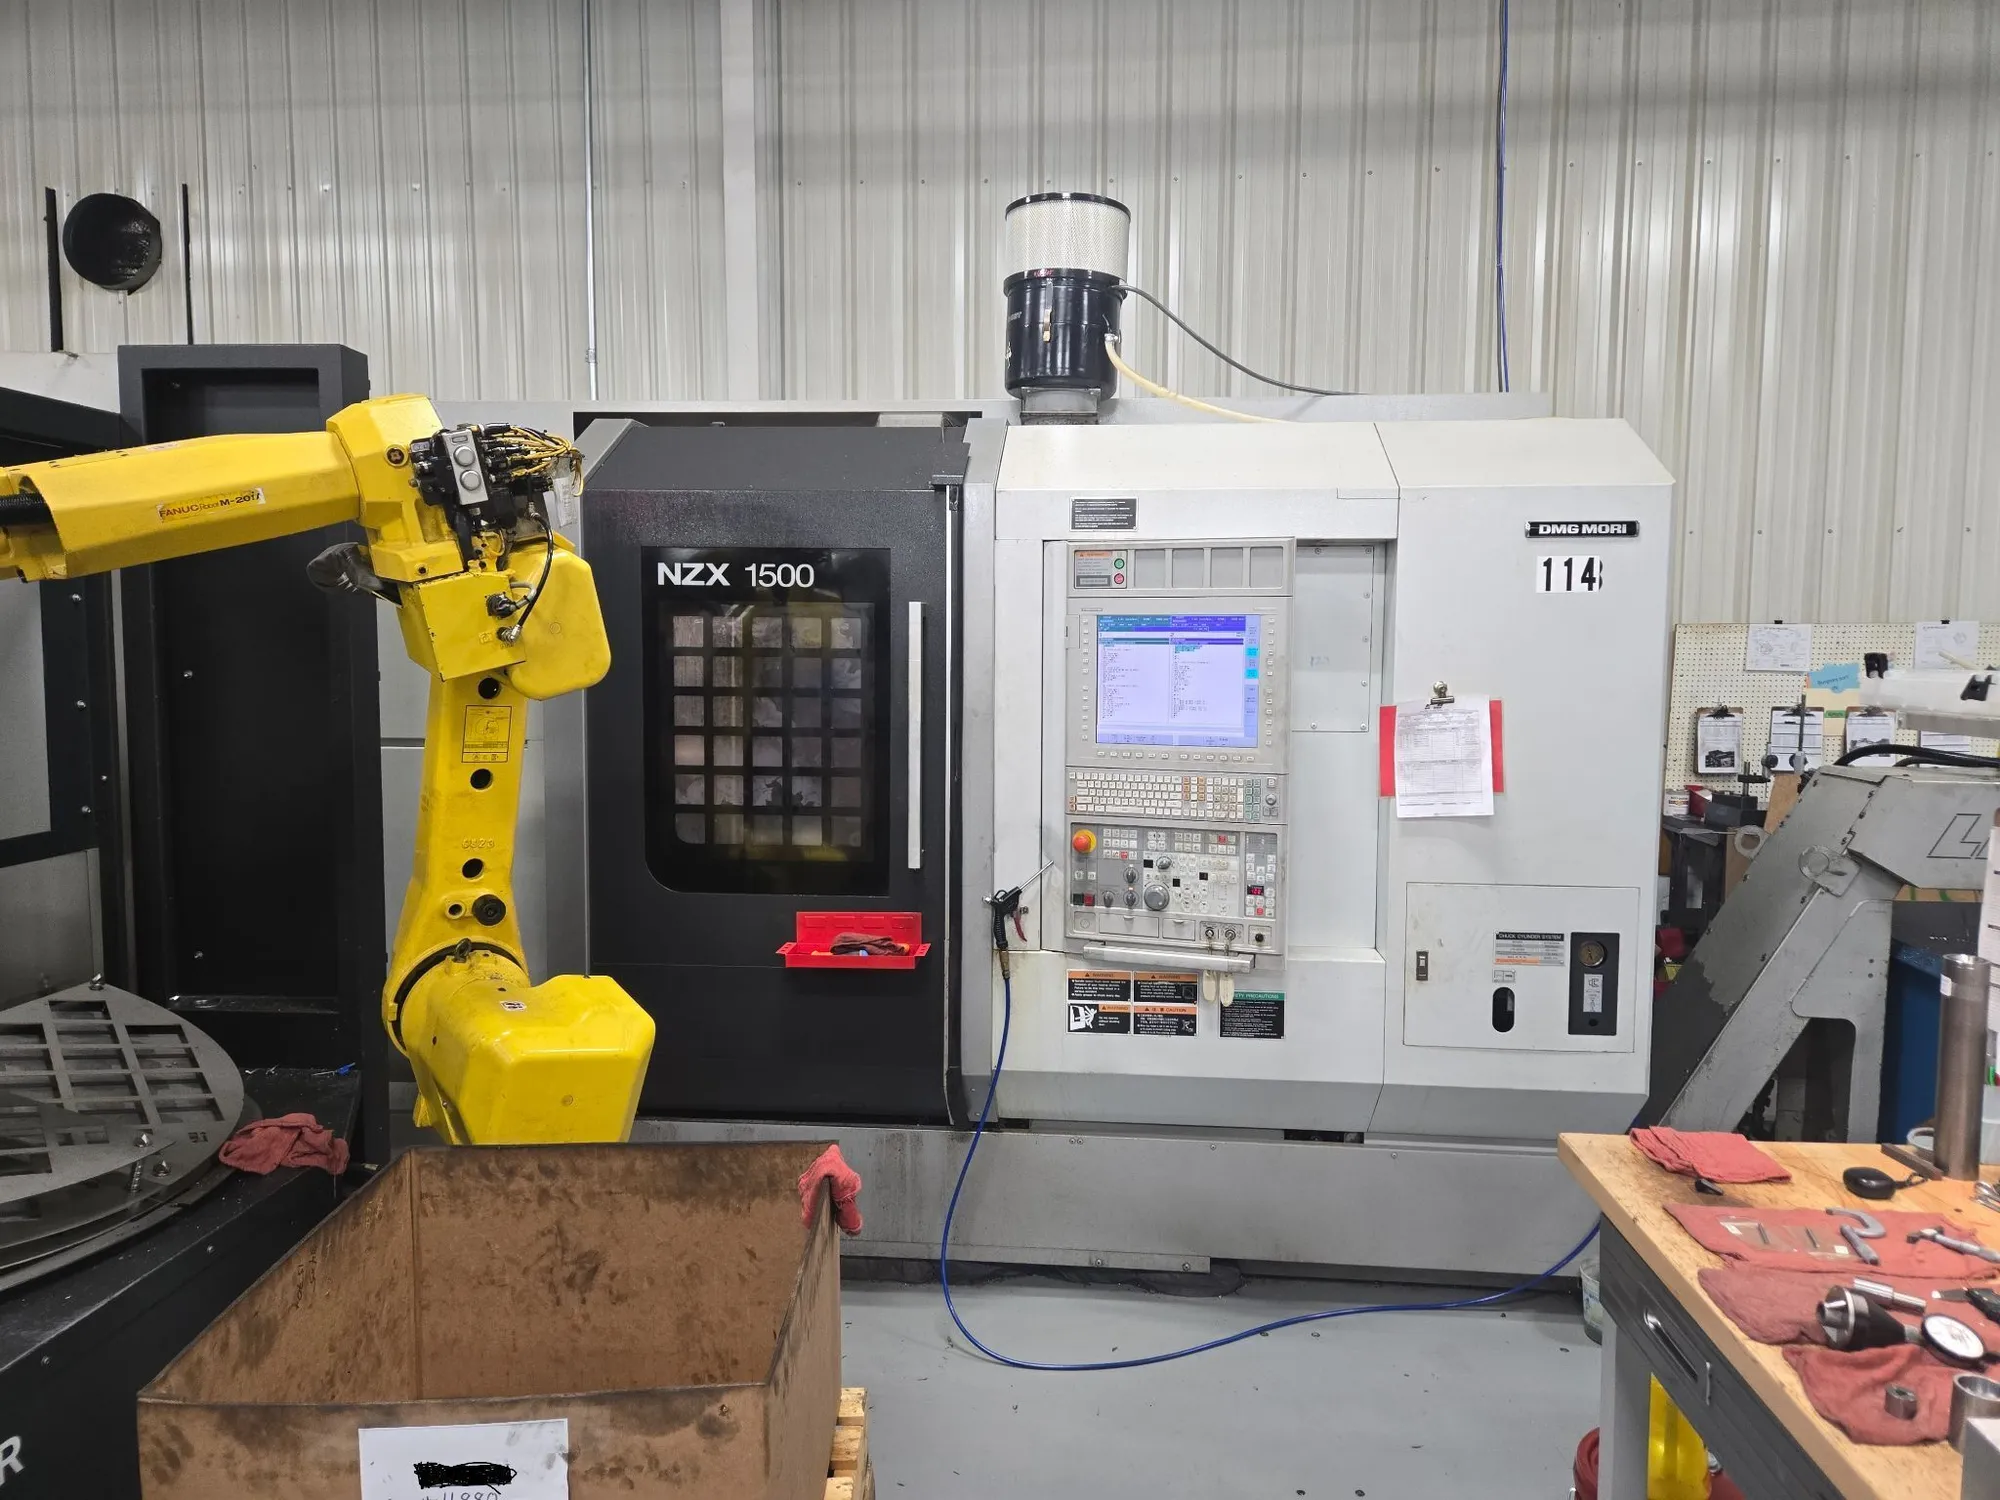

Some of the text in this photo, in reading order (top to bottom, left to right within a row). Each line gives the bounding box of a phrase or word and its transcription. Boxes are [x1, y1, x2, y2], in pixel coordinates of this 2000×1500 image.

[159, 504, 199, 517] FANUC
[1538, 523, 1627, 534] DMG MORI
[657, 562, 815, 588] NZX 1500
